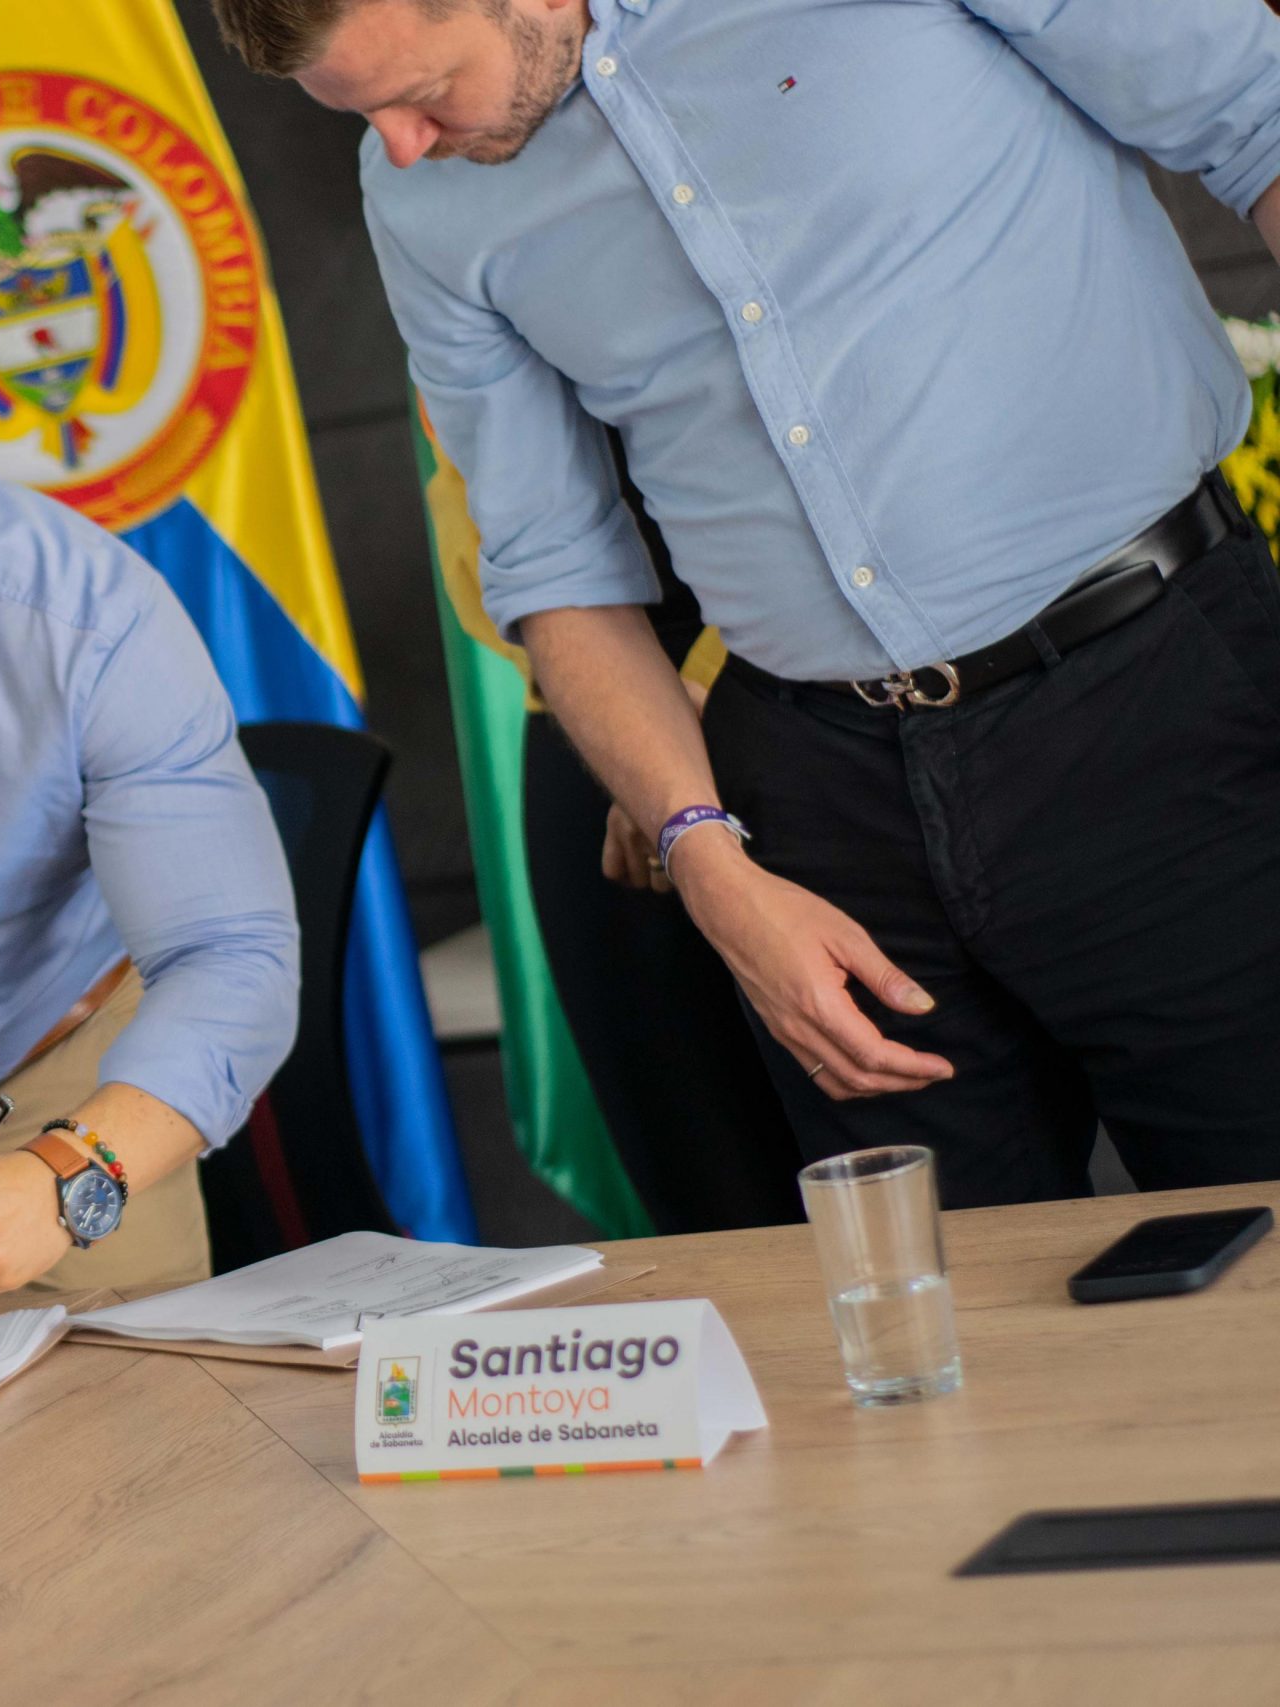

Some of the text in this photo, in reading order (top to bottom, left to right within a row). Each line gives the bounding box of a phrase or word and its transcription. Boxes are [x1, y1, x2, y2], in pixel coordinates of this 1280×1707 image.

[64, 84, 252, 371] COLOMBIA
[448, 1328, 680, 1380] Santiago
[448, 1384, 611, 1420] Montoya
[382, 1438, 424, 1448] Sabaneta
[447, 1420, 658, 1447] Alcalde de Sabaneta
